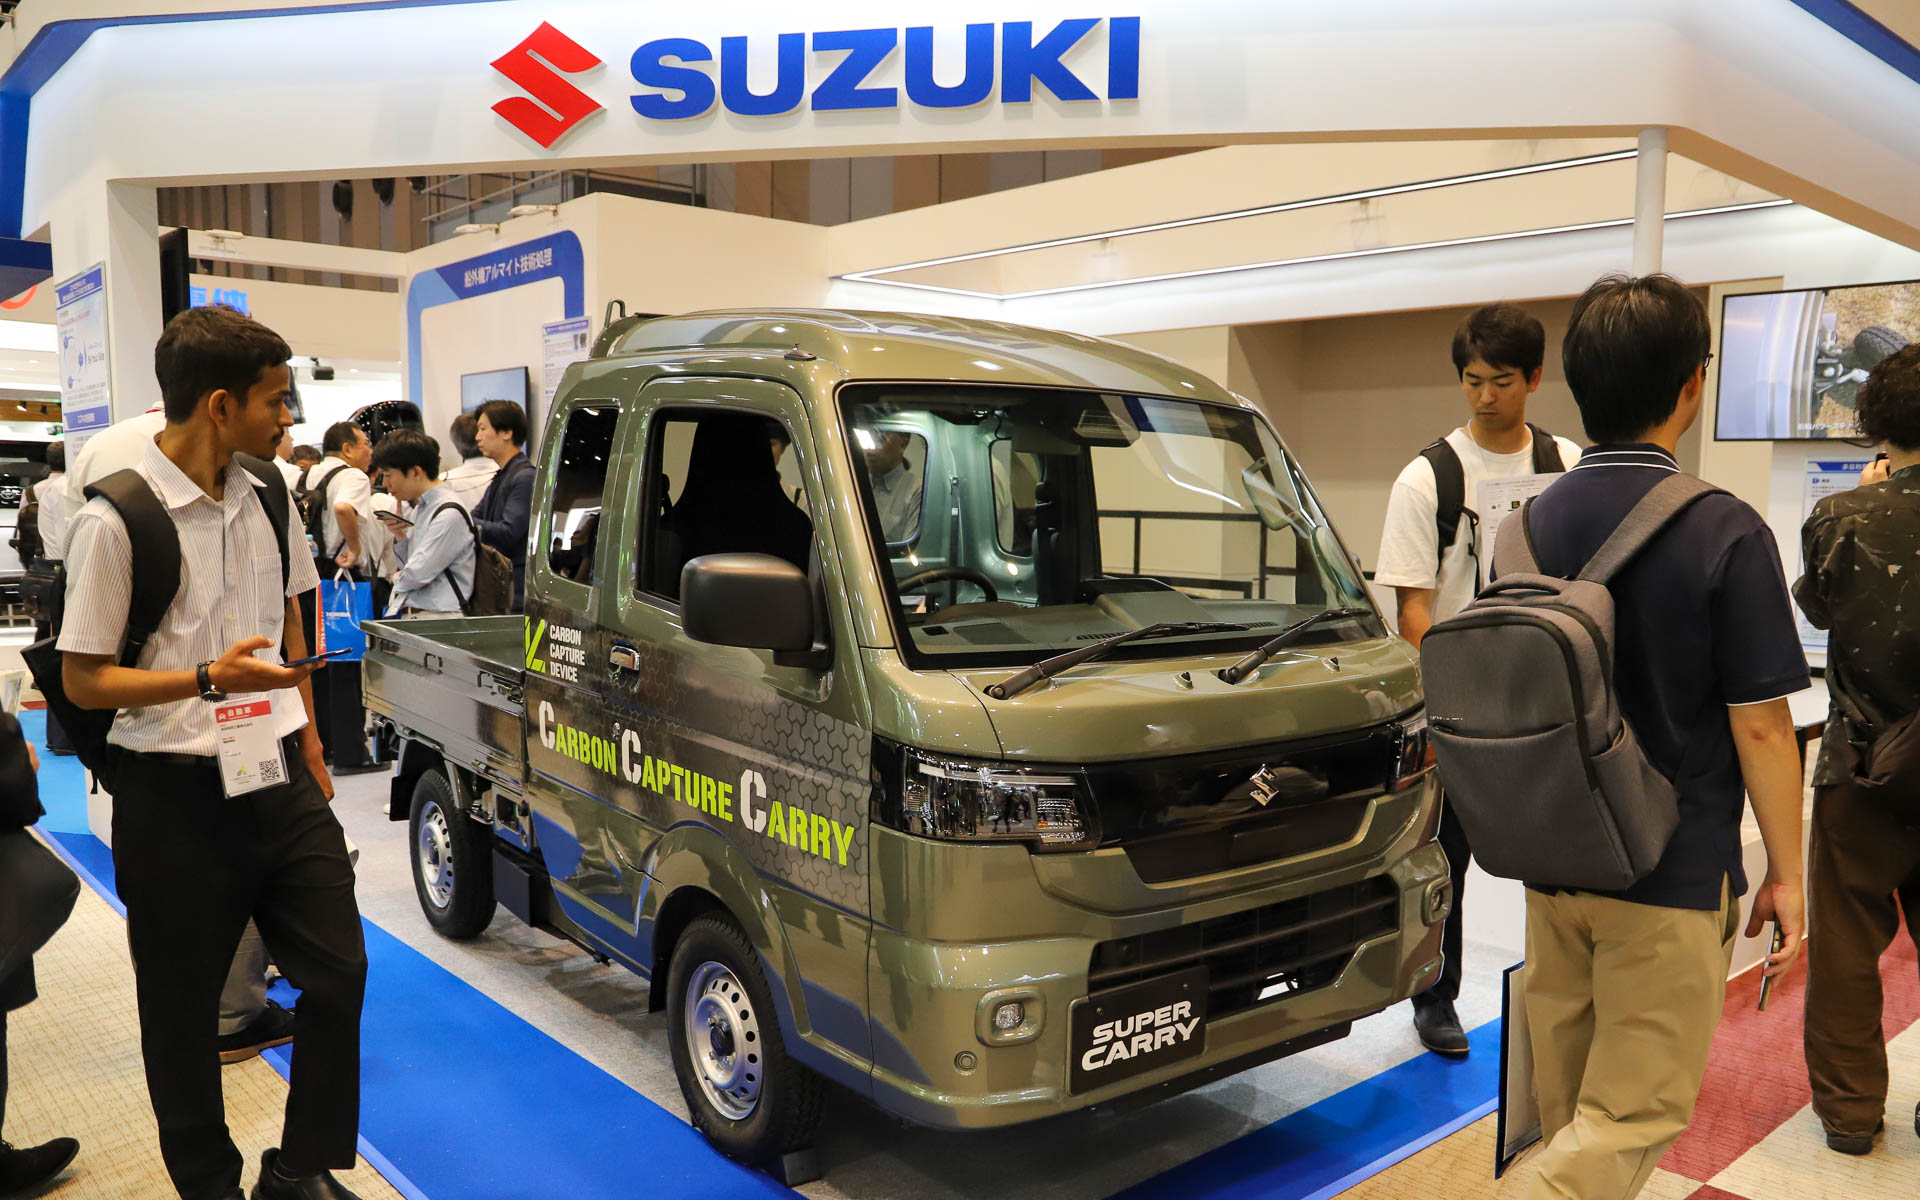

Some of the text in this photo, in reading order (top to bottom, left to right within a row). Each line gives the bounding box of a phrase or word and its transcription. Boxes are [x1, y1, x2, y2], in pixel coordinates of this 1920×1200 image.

[629, 16, 1141, 120] SUZUKI
[549, 624, 582, 646] CARBON
[549, 643, 586, 666] CAPTURE
[549, 661, 578, 683] DEVICE
[538, 700, 855, 867] CARBON CAPTURE CARRY
[1081, 1016, 1201, 1072] CARRY
[1092, 1000, 1192, 1046] SUPER
